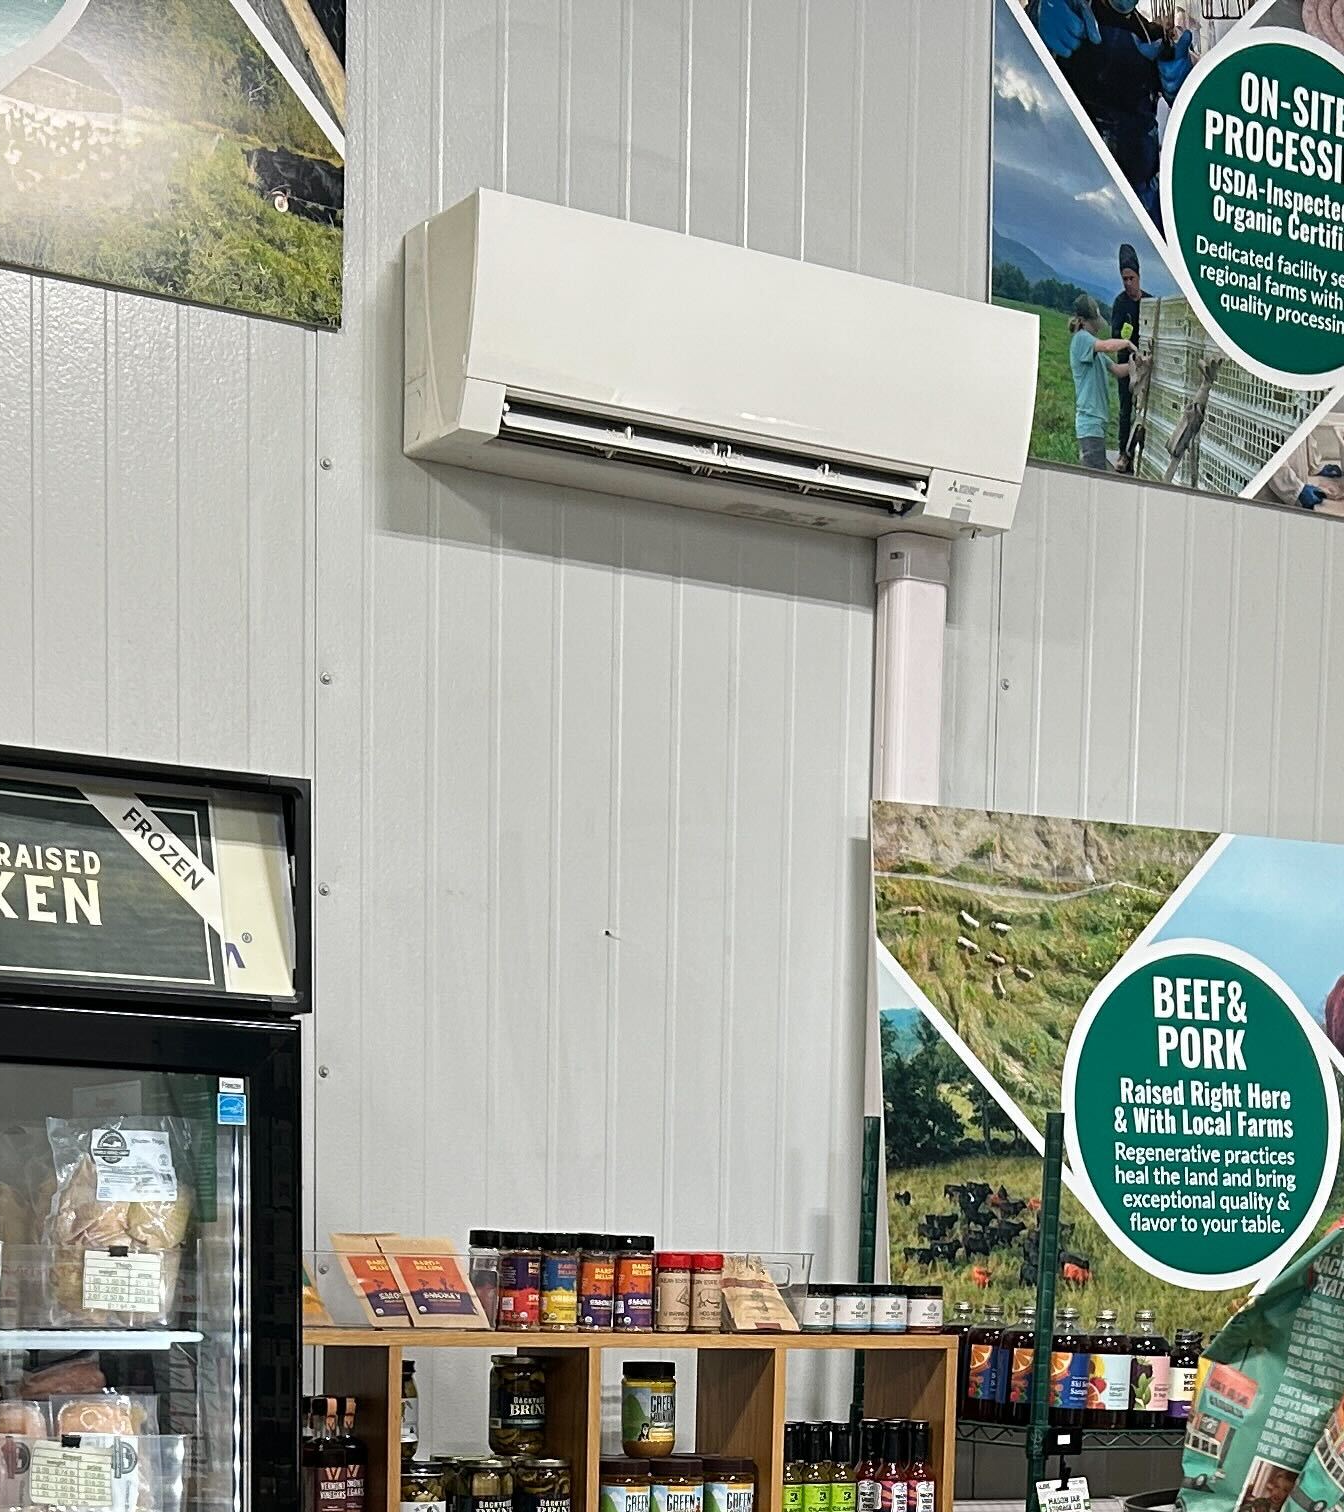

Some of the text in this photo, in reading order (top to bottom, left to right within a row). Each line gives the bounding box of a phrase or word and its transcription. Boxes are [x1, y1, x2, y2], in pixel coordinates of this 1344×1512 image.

[1213, 196, 1281, 236] Organic
[1196, 236, 1273, 271] Dedicated
[1278, 257, 1327, 288] facility
[1200, 264, 1261, 294] regional
[1265, 275, 1307, 300] farms
[1311, 286, 1343, 311] with
[1220, 293, 1272, 322] quality
[122, 807, 205, 892] FROZEN
[1158, 1026, 1247, 1071] PORK
[1121, 1078, 1291, 1112] Raised Right Here
[1114, 1109, 1293, 1138] & With Local Farms
[1115, 1142, 1294, 1166] Regenerative practices
[1115, 1166, 1296, 1191] heal the land and bring
[1123, 1191, 1289, 1213] exceptional quality &
[1130, 1213, 1284, 1235] flavor to your table.
[667, 1494, 695, 1511] GREEN
